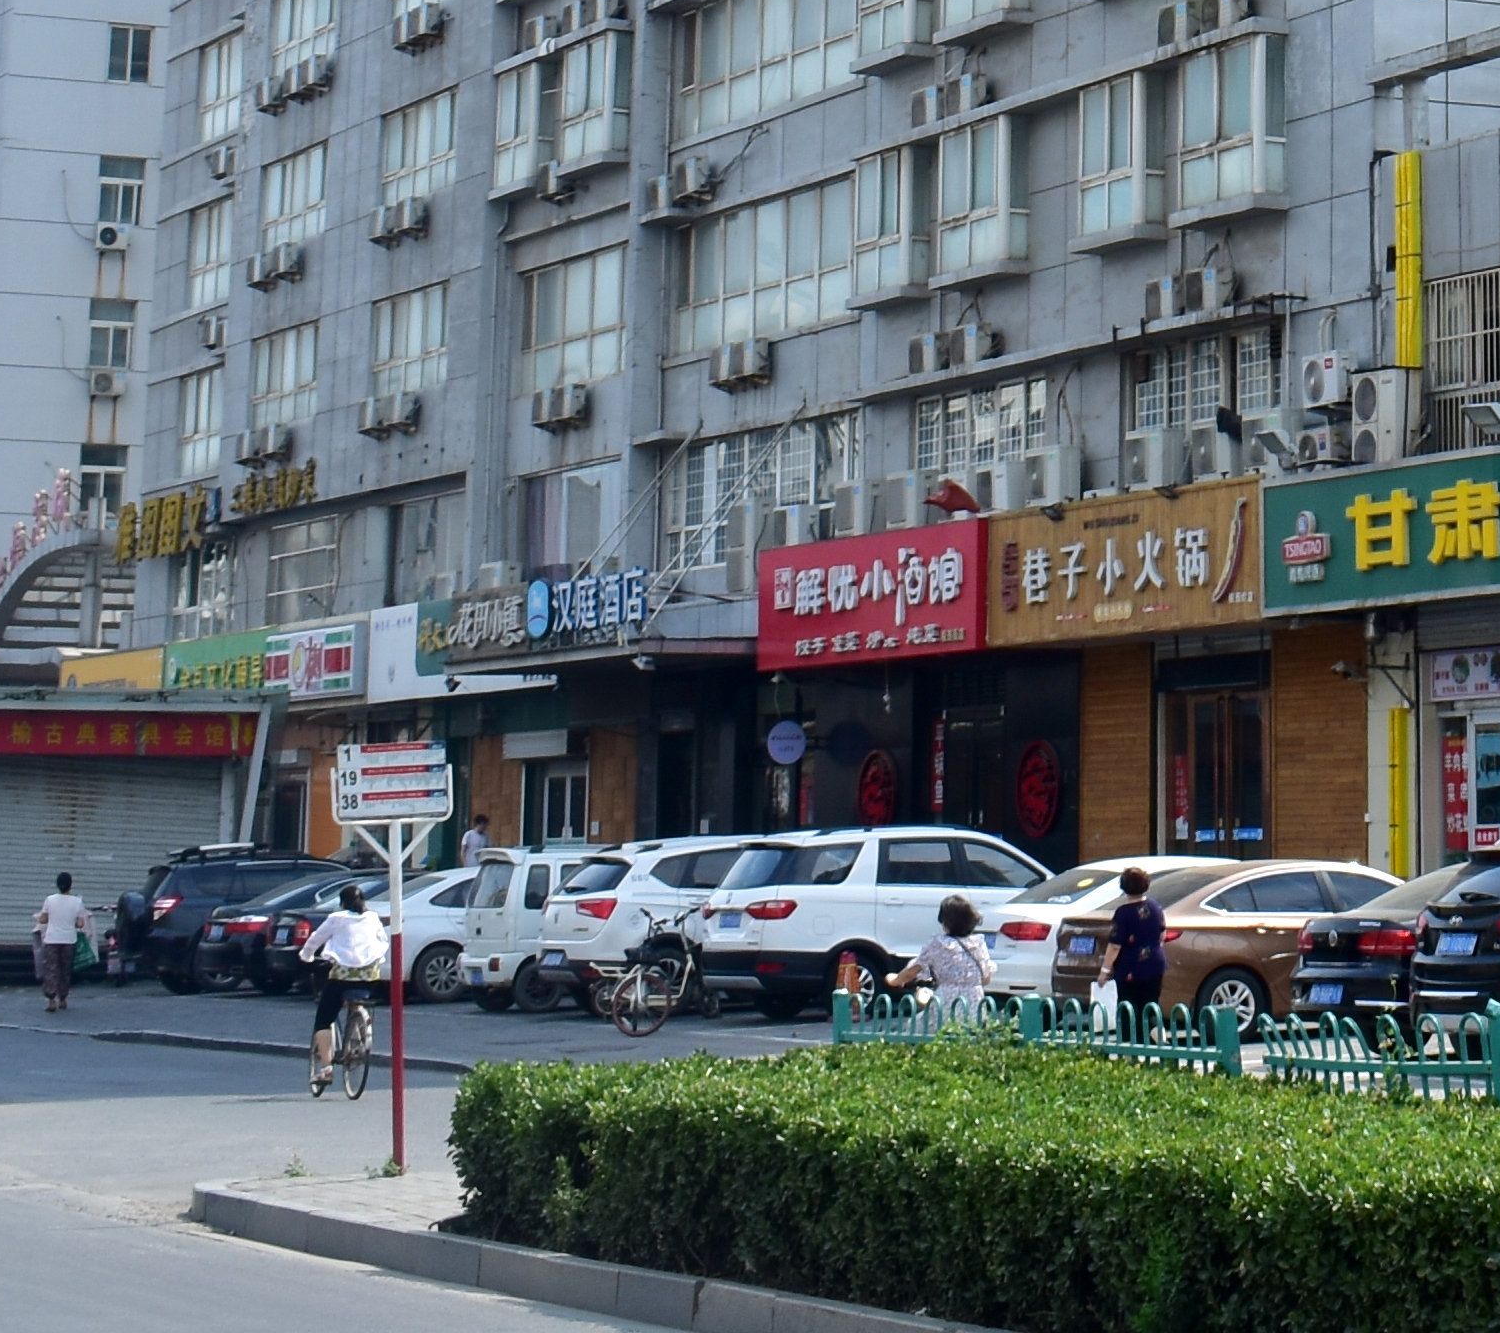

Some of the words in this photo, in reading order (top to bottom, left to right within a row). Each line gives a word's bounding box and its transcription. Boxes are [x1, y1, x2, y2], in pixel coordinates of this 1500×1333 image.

[552, 565, 648, 633] 汉庭酒店
[344, 747, 350, 762] 1
[341, 771, 357, 786] 19
[342, 795, 358, 810] 38
